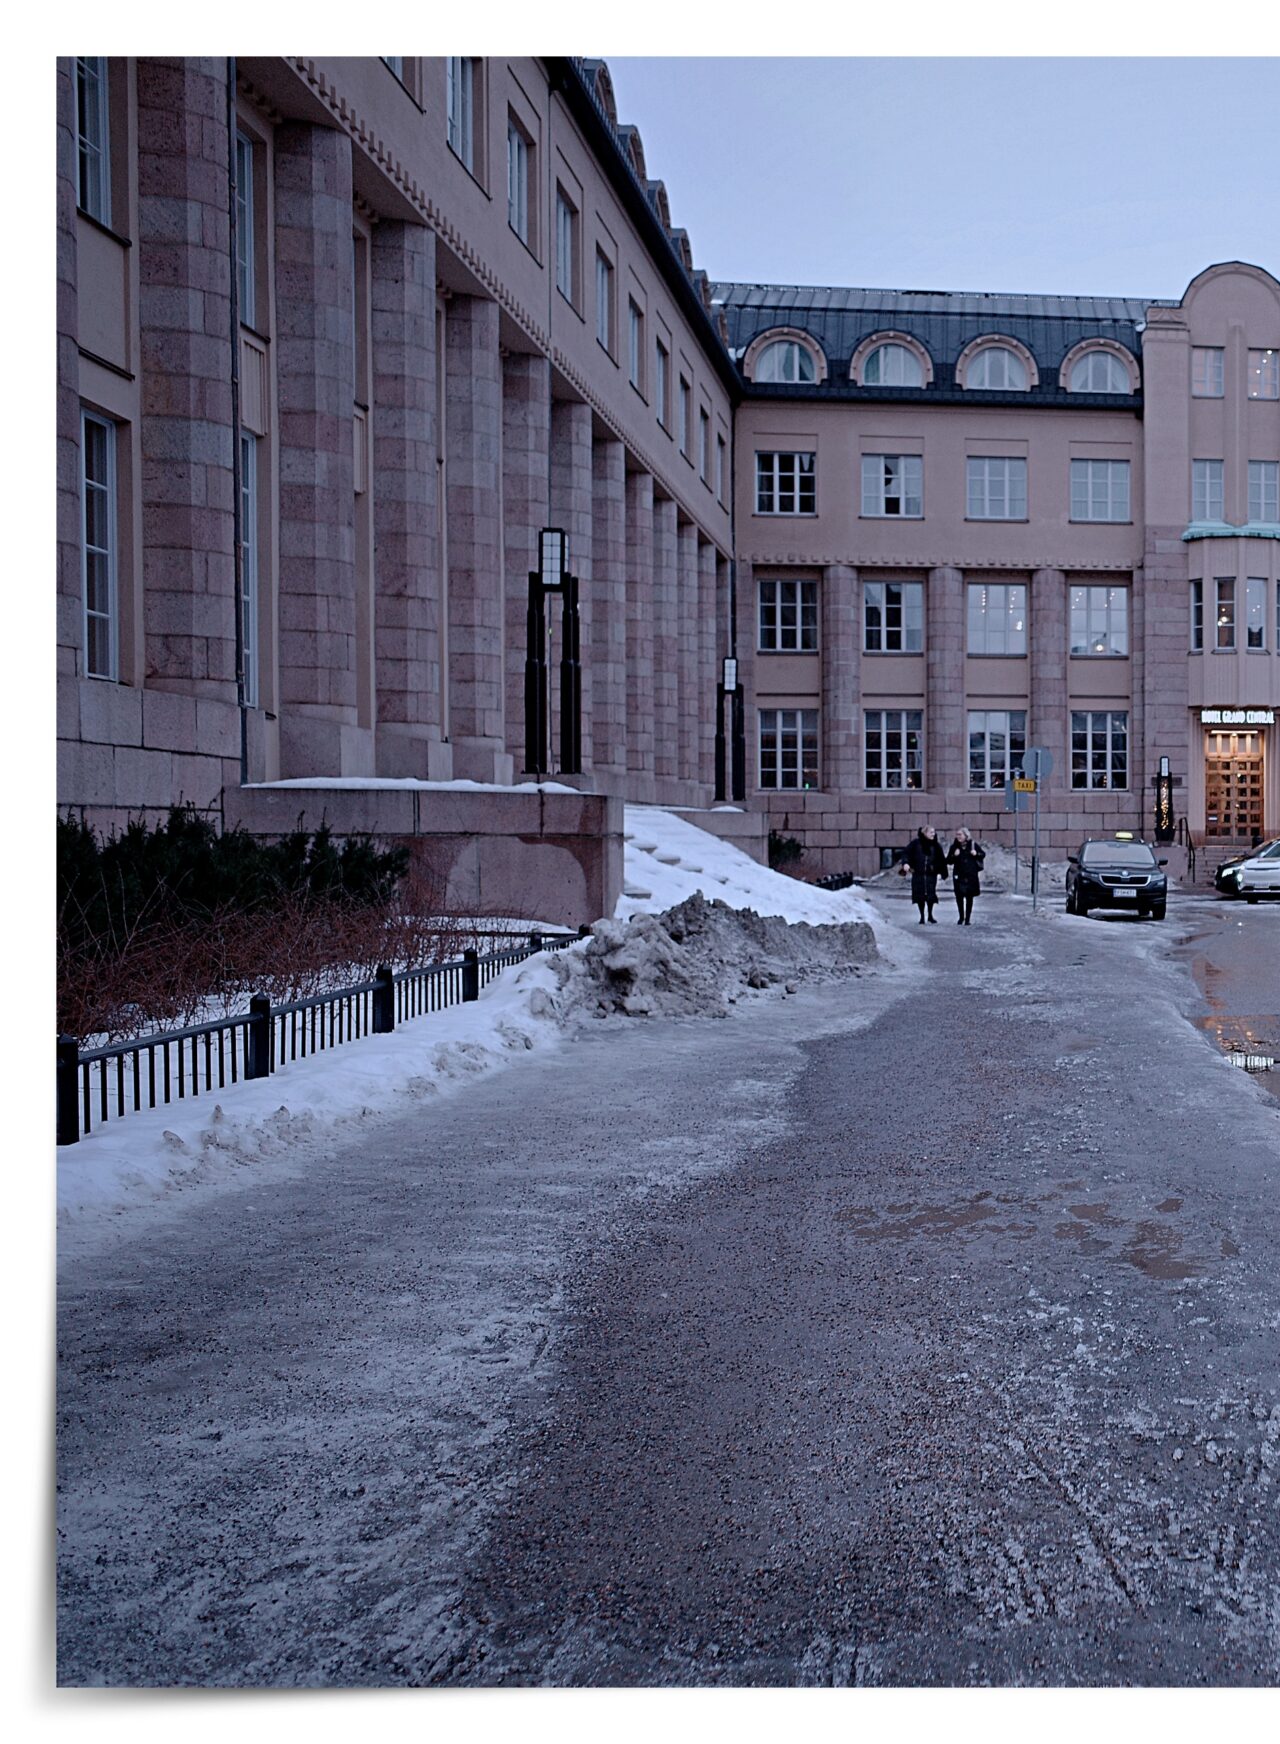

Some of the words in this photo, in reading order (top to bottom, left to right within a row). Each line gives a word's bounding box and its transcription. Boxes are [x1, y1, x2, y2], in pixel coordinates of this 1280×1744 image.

[1201, 710, 1222, 724] HOTEL
[1222, 710, 1246, 724] GRAND
[1246, 711, 1275, 724] CENTRAL
